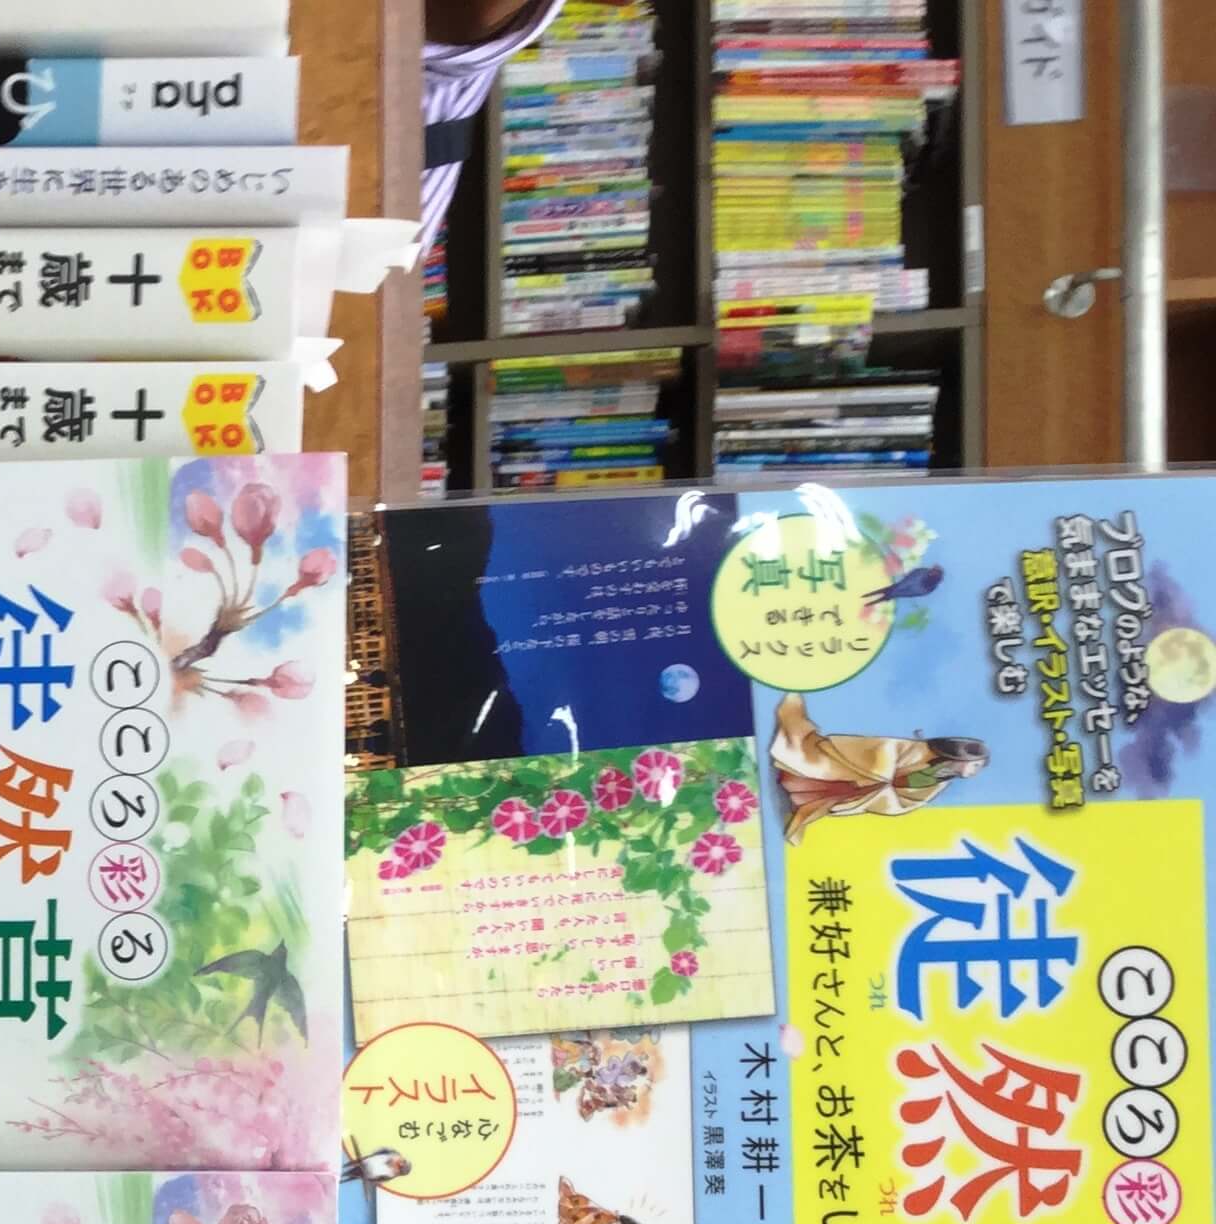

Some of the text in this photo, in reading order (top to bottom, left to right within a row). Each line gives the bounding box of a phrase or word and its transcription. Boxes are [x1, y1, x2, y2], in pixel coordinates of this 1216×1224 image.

[150, 73, 243, 116] pha
[740, 548, 846, 597] 写真
[765, 604, 842, 626] できる
[987, 579, 1027, 695] で楽しむ
[1100, 510, 1151, 724] ブログのような、
[740, 636, 870, 660] リラックス
[1058, 515, 1121, 793] 気ままなエッセーを
[1022, 550, 1084, 811] 意訳・イラスト・写真
[97, 655, 156, 968] こころ彩る
[869, 973, 888, 1011] つれ
[349, 1073, 497, 1106] イラスト
[398, 1117, 499, 1142] 心なごむ
[703, 1070, 726, 1196] イラスト 黒澤葵
[739, 1042, 780, 1221] 木村耕一
[878, 1180, 899, 1217] づれ
